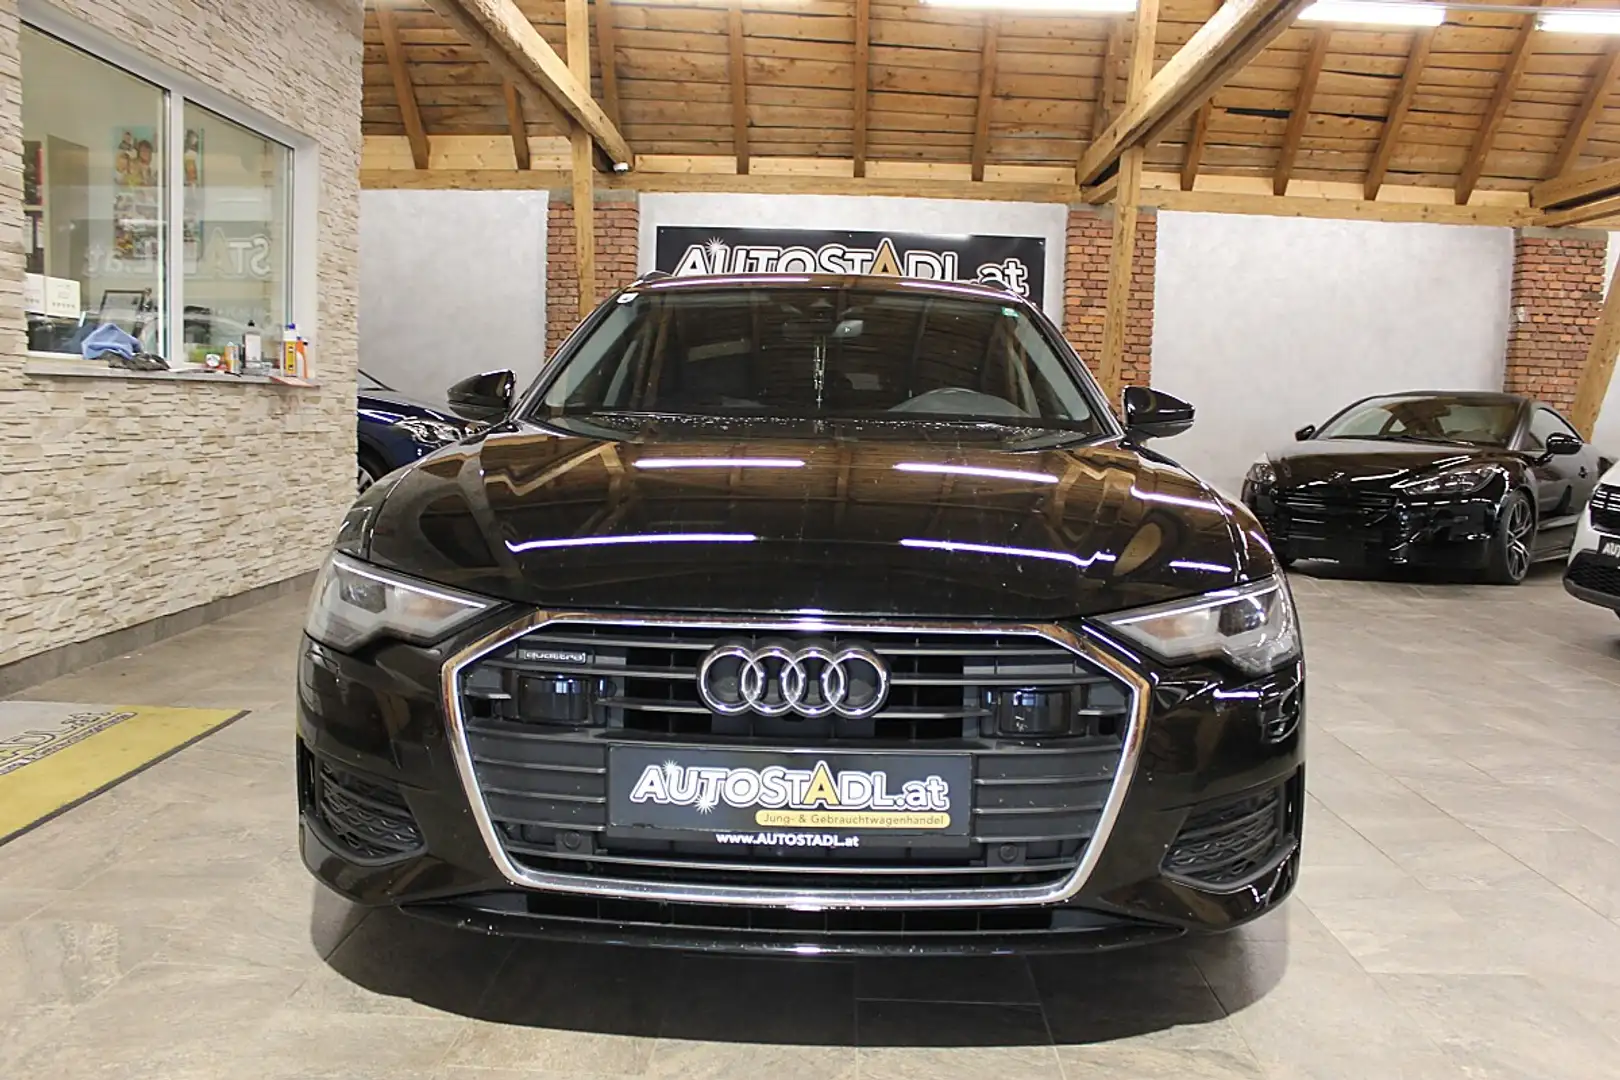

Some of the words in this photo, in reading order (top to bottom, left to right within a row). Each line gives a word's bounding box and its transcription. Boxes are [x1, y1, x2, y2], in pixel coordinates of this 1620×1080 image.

[630, 760, 950, 812] AUTOSTADL.at
[763, 813, 794, 826] Jung-
[798, 814, 807, 825] &
[810, 814, 945, 828] Gebrauchtwagenhandel
[715, 832, 860, 849] www.AUTOSTADL.at
